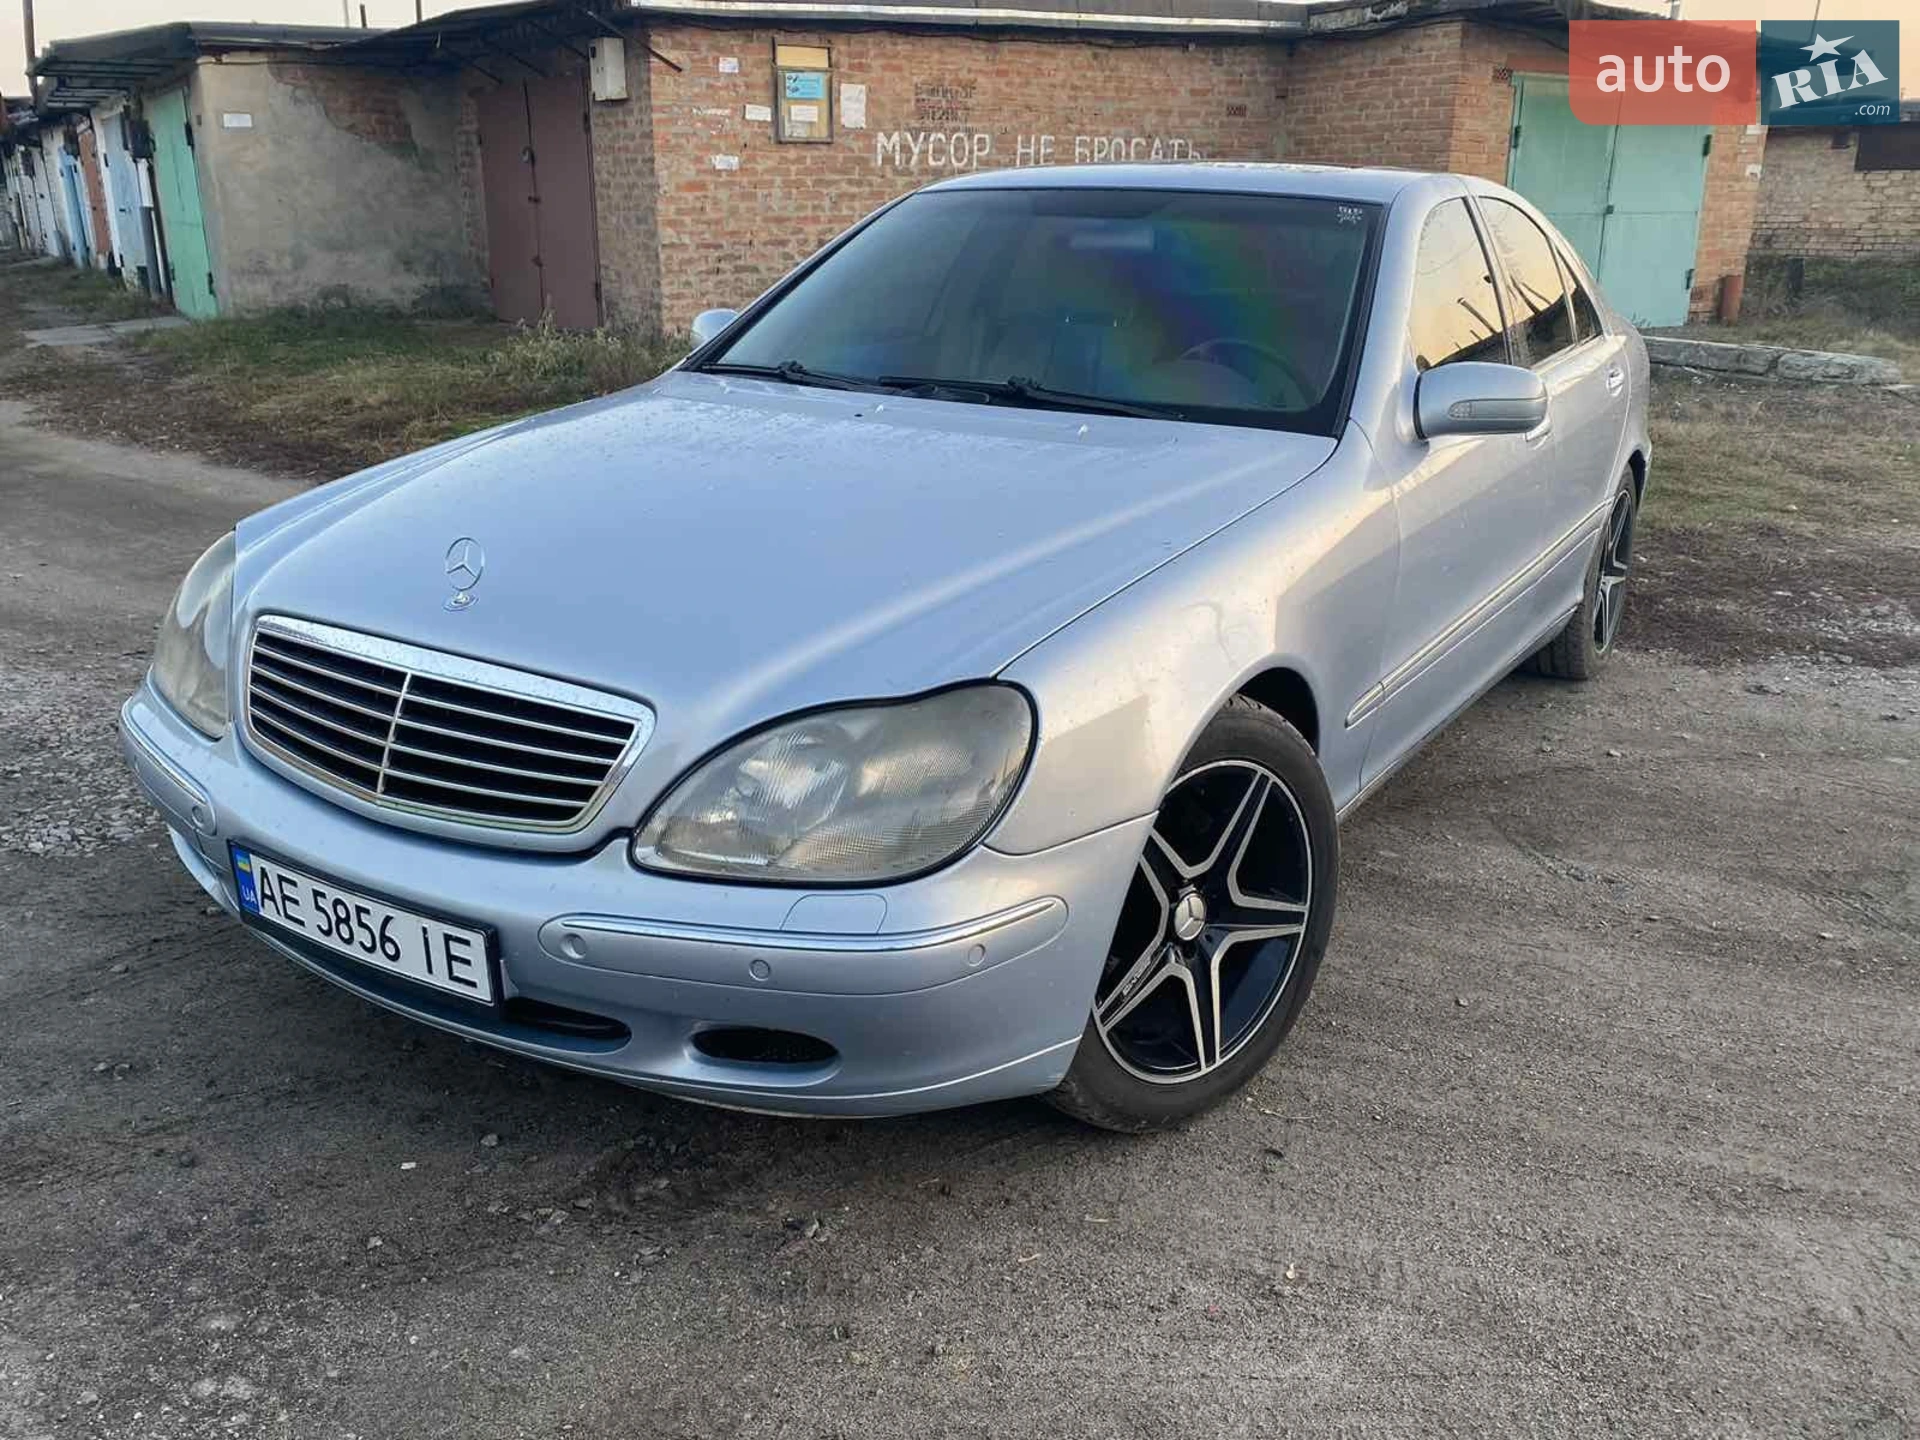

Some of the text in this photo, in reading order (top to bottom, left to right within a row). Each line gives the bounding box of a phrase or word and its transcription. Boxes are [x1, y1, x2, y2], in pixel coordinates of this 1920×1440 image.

[875, 131, 1201, 170] МУСОР НЕ БРОСАТЬ
[241, 885, 257, 904] UA
[259, 866, 478, 989] AE 5856 IE
